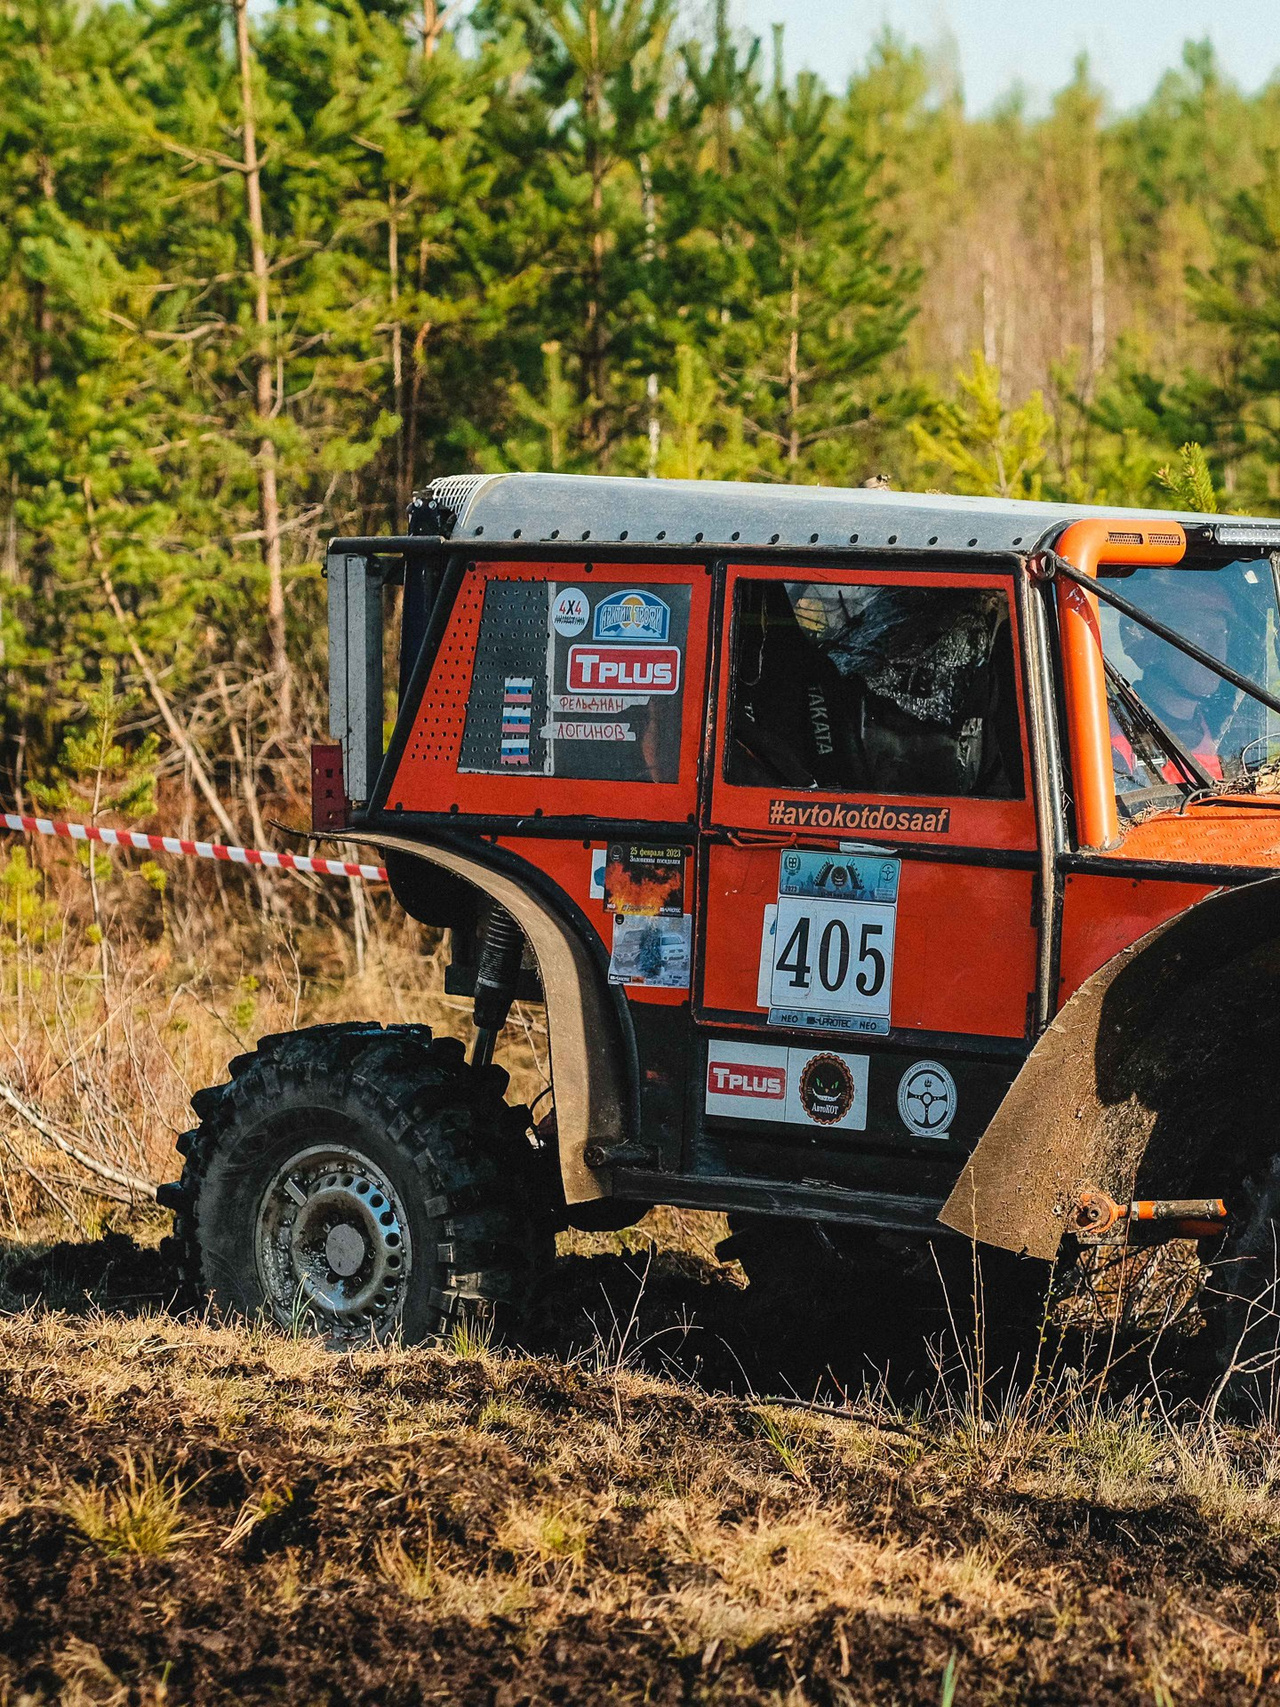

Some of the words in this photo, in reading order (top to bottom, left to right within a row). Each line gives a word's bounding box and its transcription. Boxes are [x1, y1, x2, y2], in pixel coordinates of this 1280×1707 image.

[808, 683, 833, 755] TAKATA
[557, 723, 625, 741] ЛОГИНОВ
[770, 801, 948, 832] #avtokotdosaaf
[630, 847, 638, 855] 25
[639, 848, 664, 858] февраля
[666, 849, 681, 858] 2023
[775, 917, 886, 997] 405
[781, 1014, 798, 1023] NEO
[859, 1021, 877, 1031] NEO
